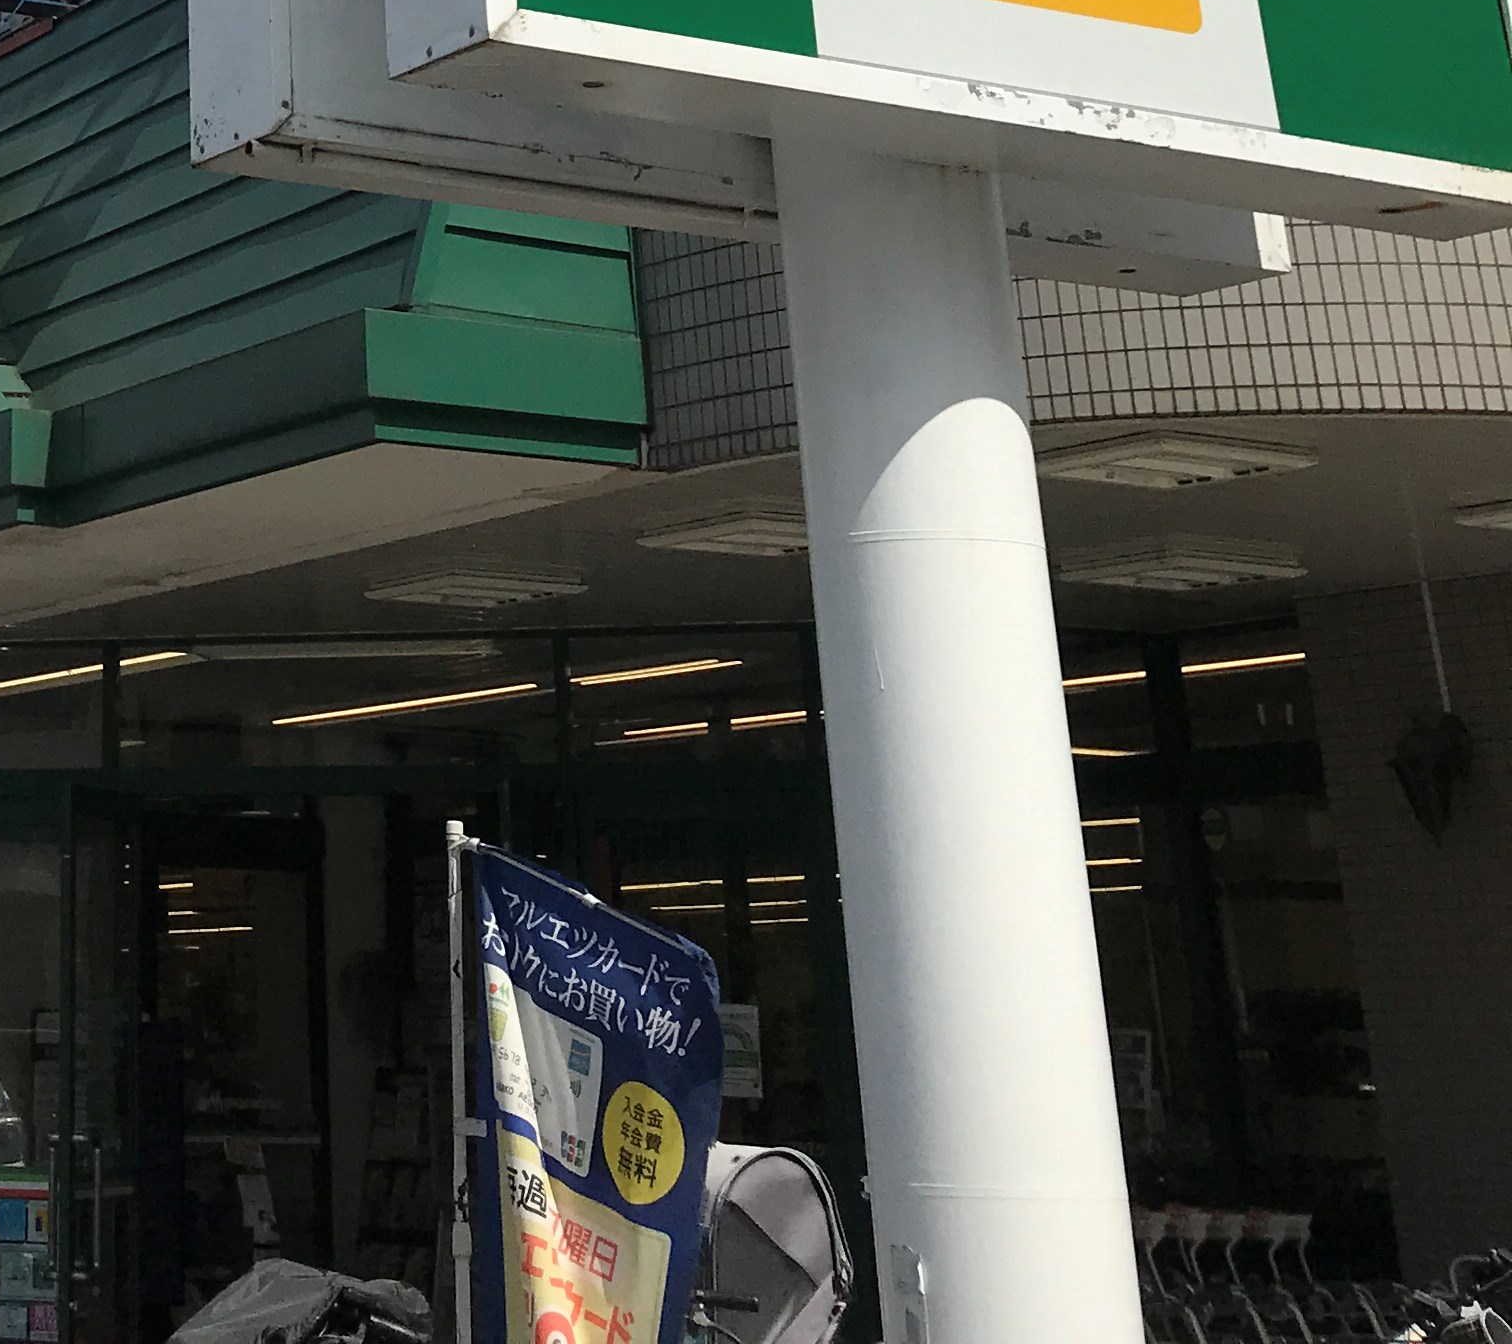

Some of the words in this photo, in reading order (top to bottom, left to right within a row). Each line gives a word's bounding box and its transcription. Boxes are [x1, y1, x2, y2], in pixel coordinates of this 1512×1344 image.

[500, 885, 692, 1006] マルエツカードで
[622, 1095, 664, 1130] 入会金
[620, 1120, 663, 1155] 年会費
[617, 1145, 657, 1189] 無料
